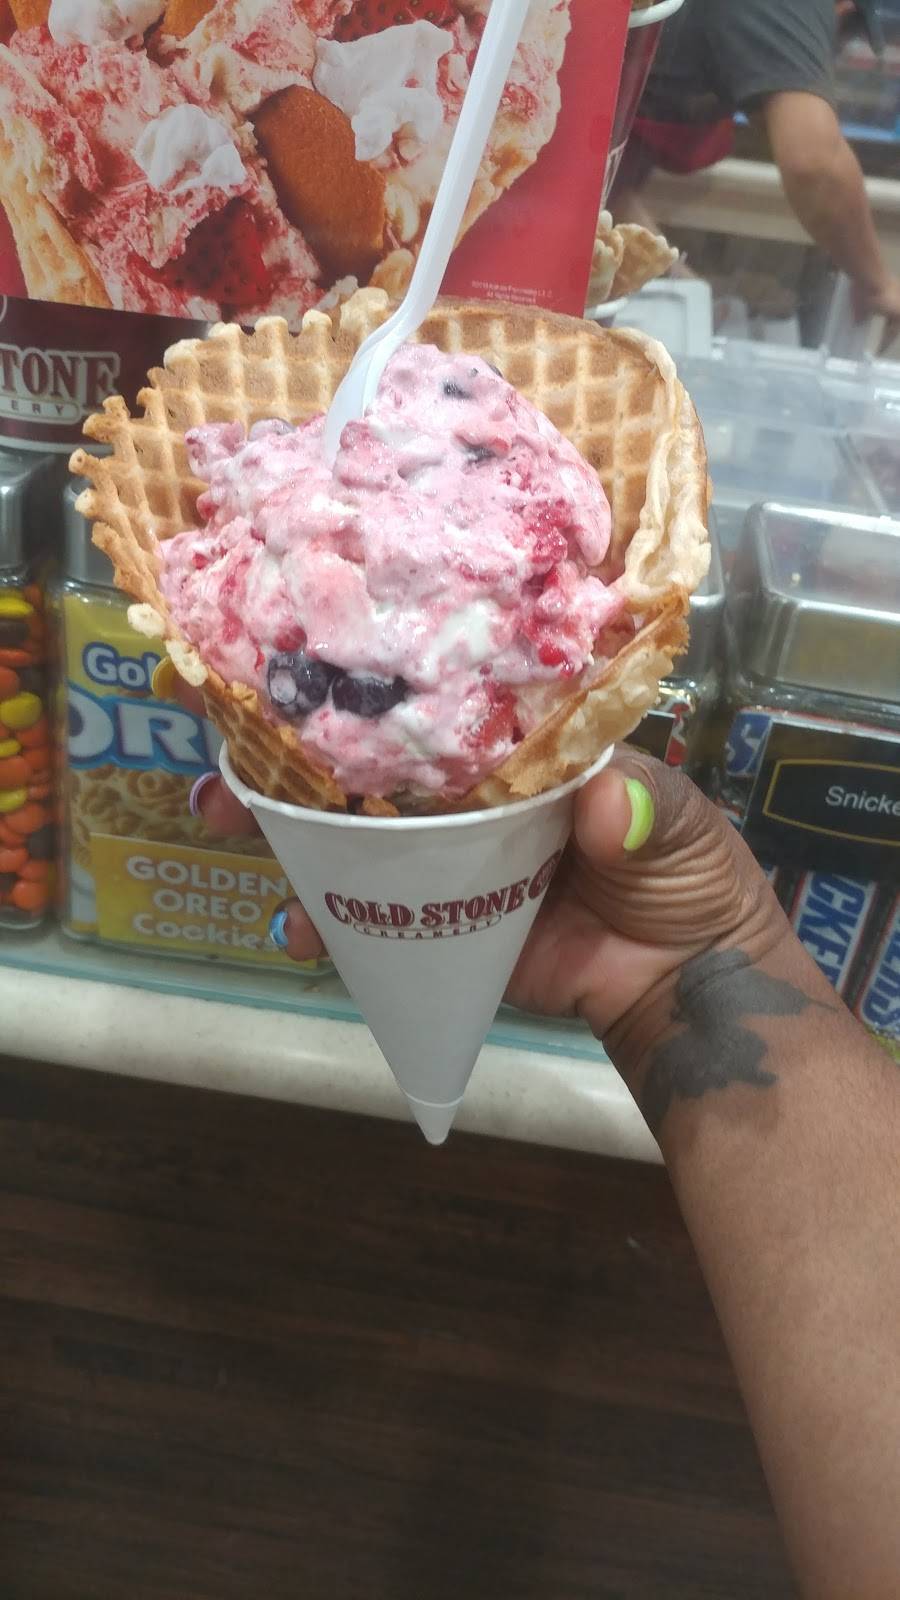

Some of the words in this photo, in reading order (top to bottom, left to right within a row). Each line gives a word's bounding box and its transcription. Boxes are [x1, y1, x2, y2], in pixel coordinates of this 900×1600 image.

[126, 855, 289, 898] GOLDEN
[153, 888, 262, 924] OREO
[324, 890, 415, 928] COLD
[420, 877, 529, 926] STONE
[363, 920, 494, 939] CREAMERY
